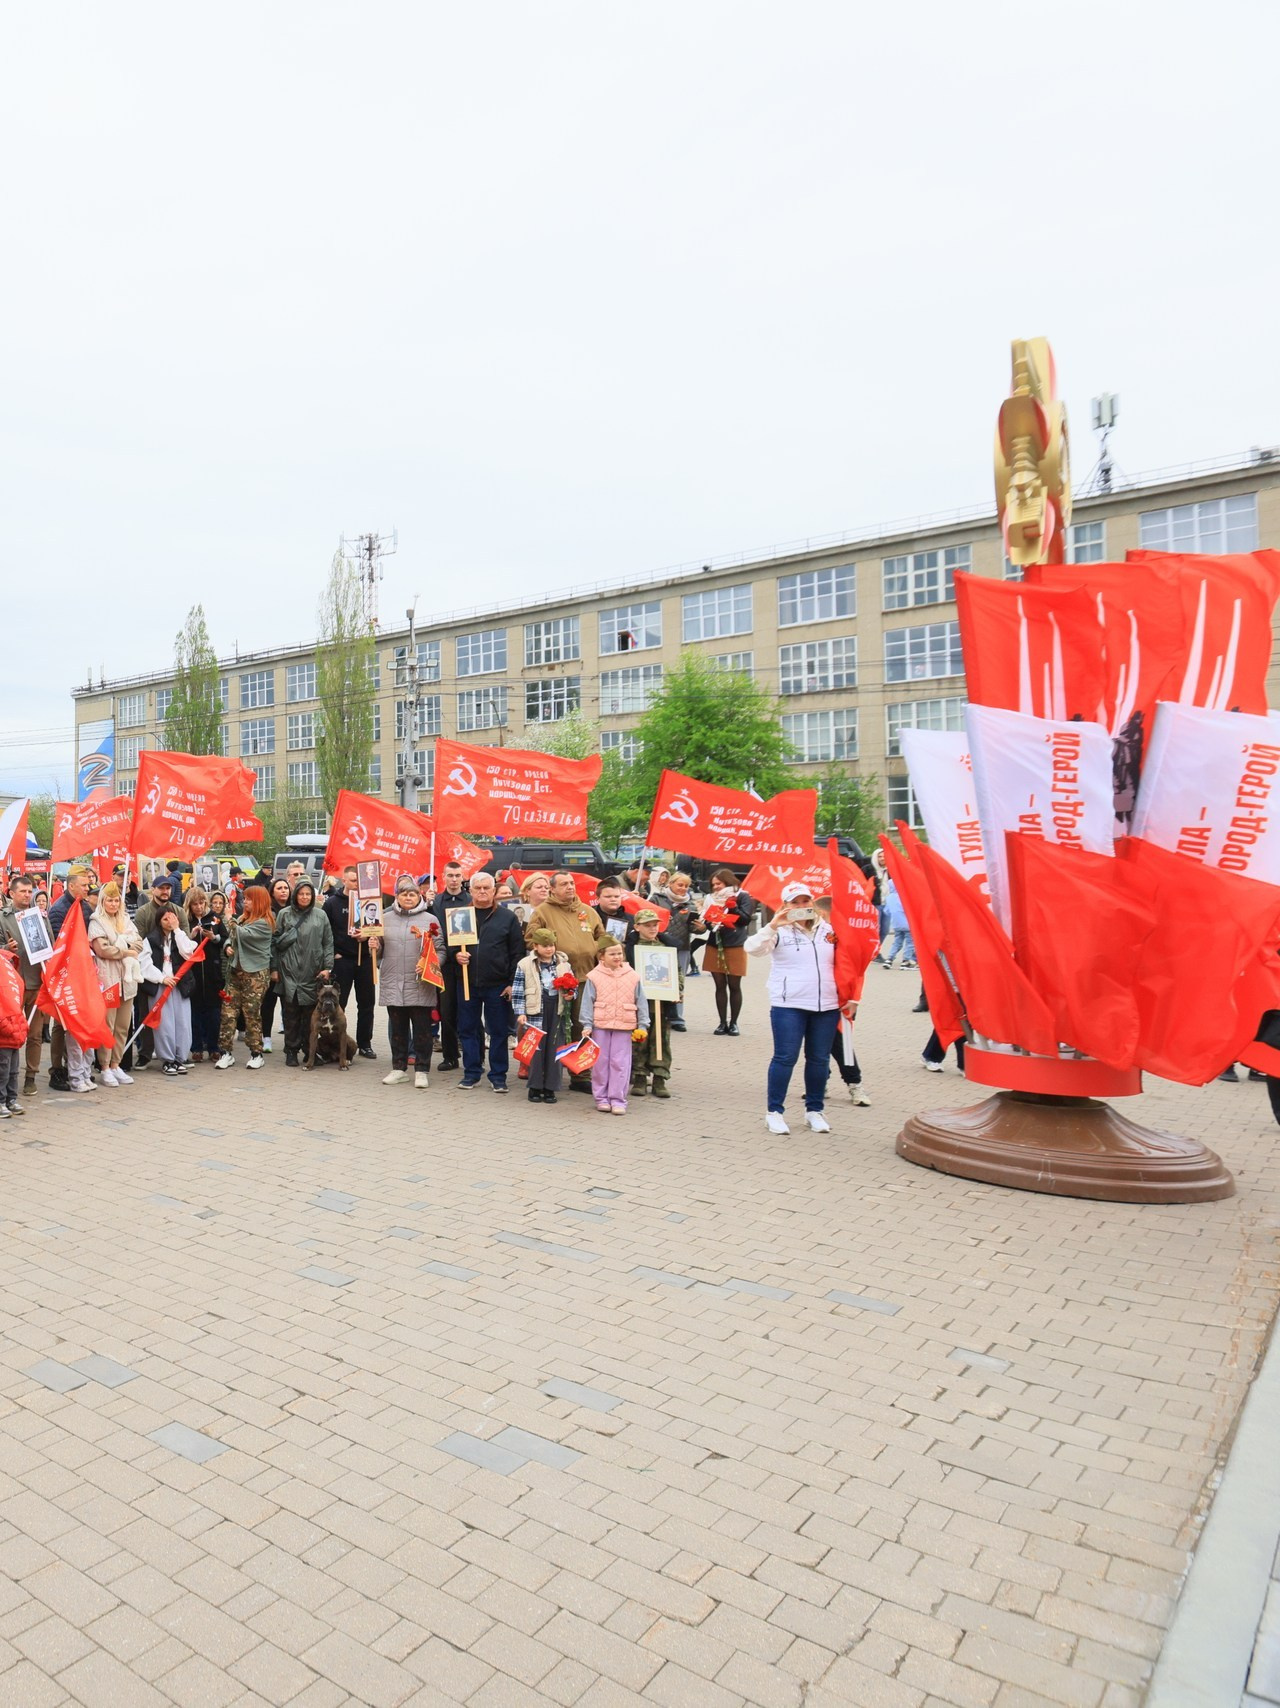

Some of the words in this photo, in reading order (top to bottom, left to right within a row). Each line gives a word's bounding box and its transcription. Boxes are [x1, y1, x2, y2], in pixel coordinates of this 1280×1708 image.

[486, 765, 501, 775] 150
[503, 804, 520, 824] 79
[710, 805, 725, 815] 150
[169, 825, 185, 845] 79
[714, 836, 736, 851] 79
[956, 820, 985, 864] ТУЛА
